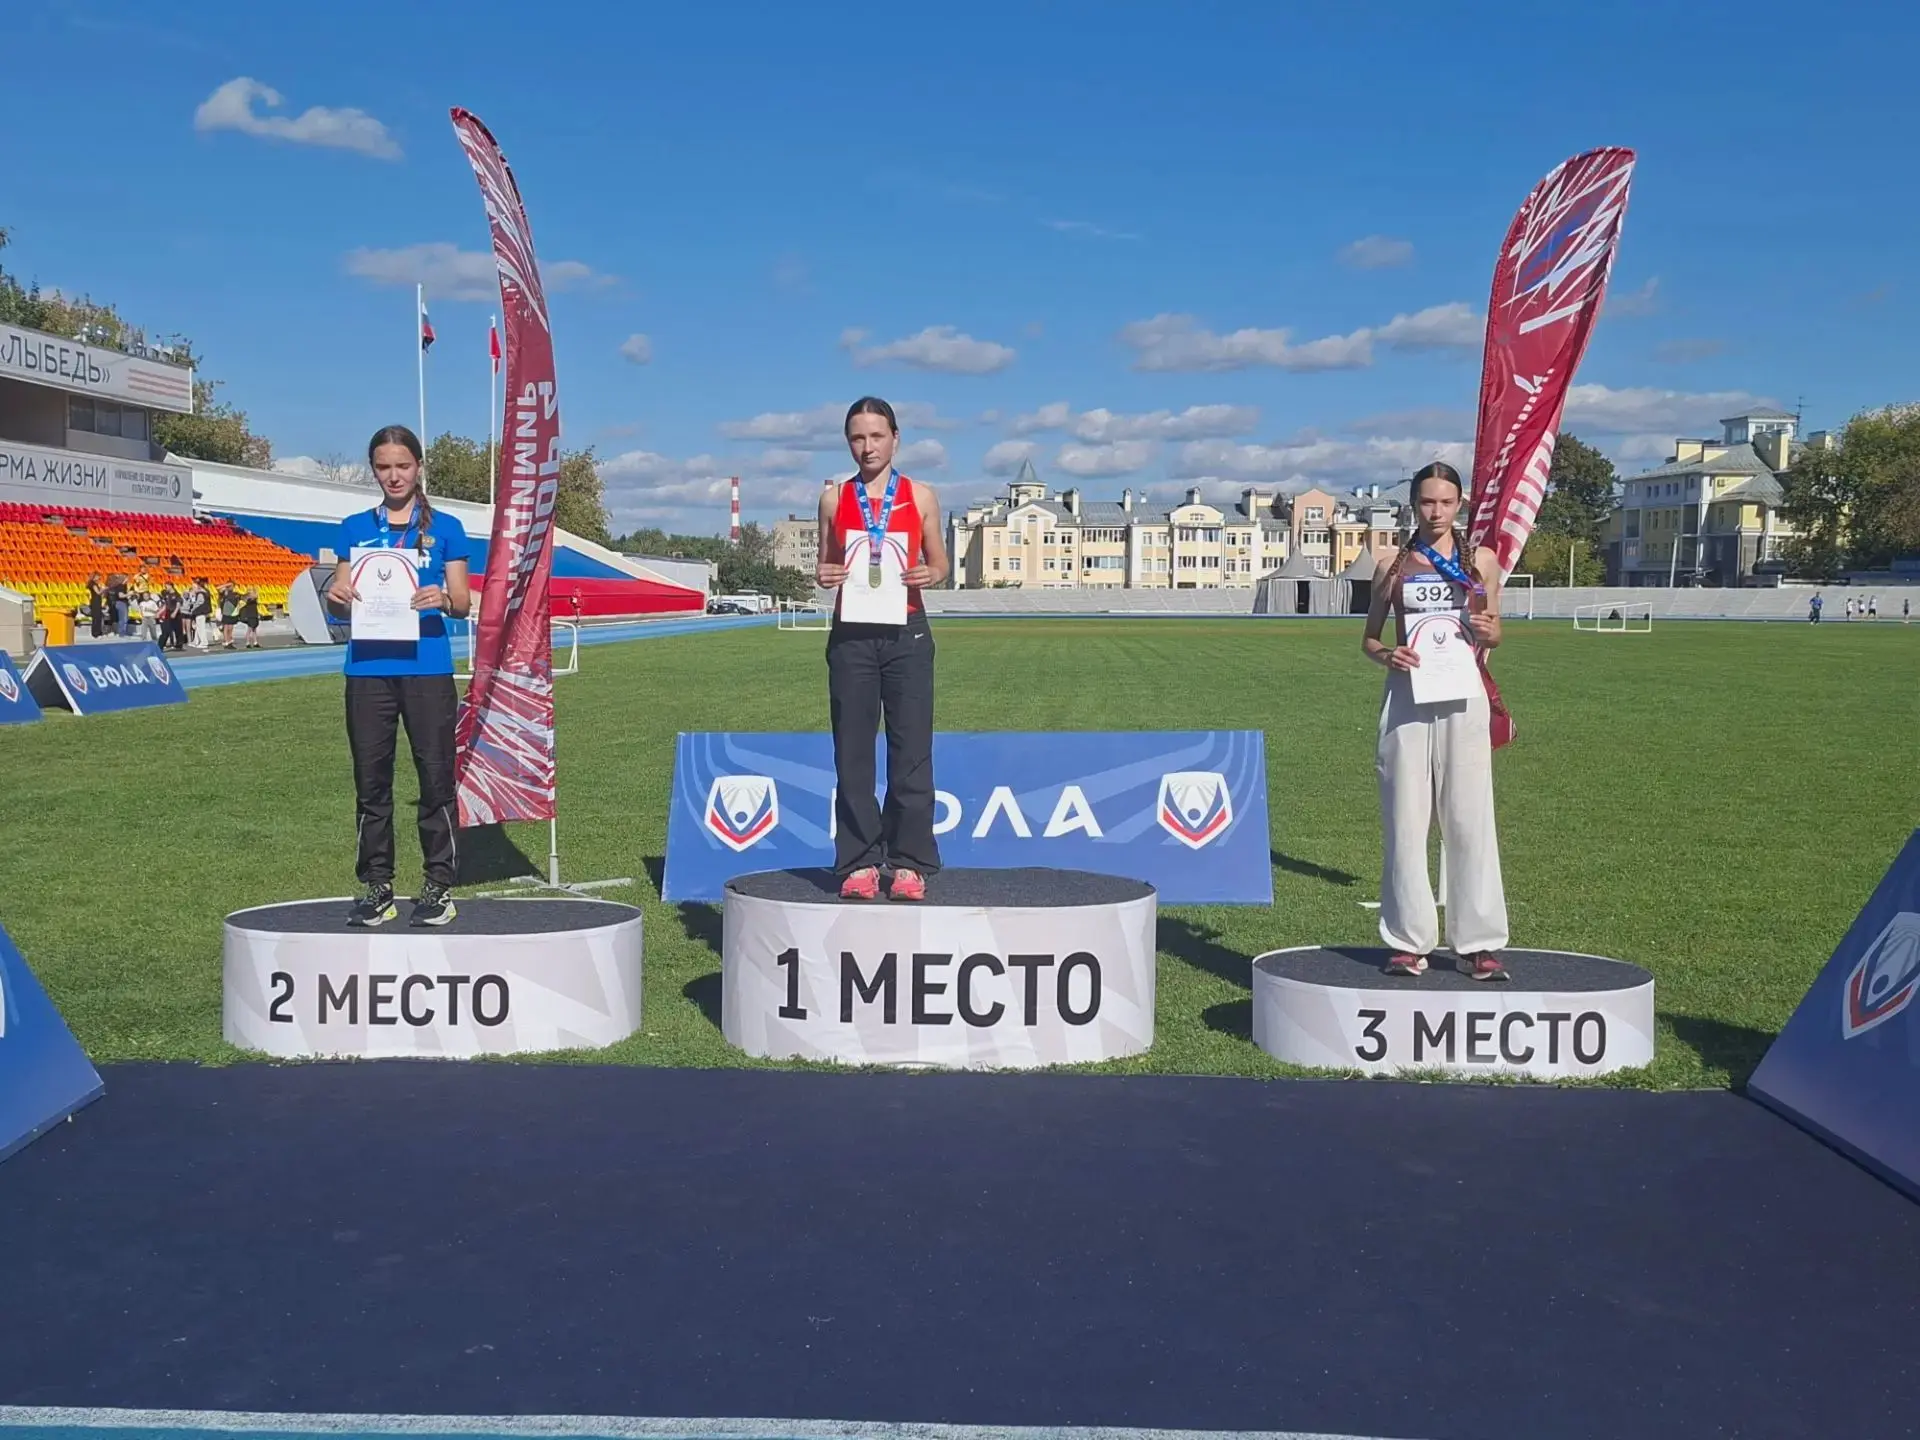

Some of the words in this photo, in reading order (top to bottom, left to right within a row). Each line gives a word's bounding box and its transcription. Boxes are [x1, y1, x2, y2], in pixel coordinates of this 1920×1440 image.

[43, 459, 107, 489] ЖИЗНИ
[1416, 586, 1455, 602] 392
[88, 663, 149, 688] ВФЛА
[269, 971, 295, 1024] 2
[317, 973, 510, 1026] МЕСТО
[776, 948, 808, 1022] 1
[840, 951, 1102, 1027] МЕСТО
[1355, 1009, 1388, 1062] 3
[1413, 1011, 1607, 1065] МЕСТО
